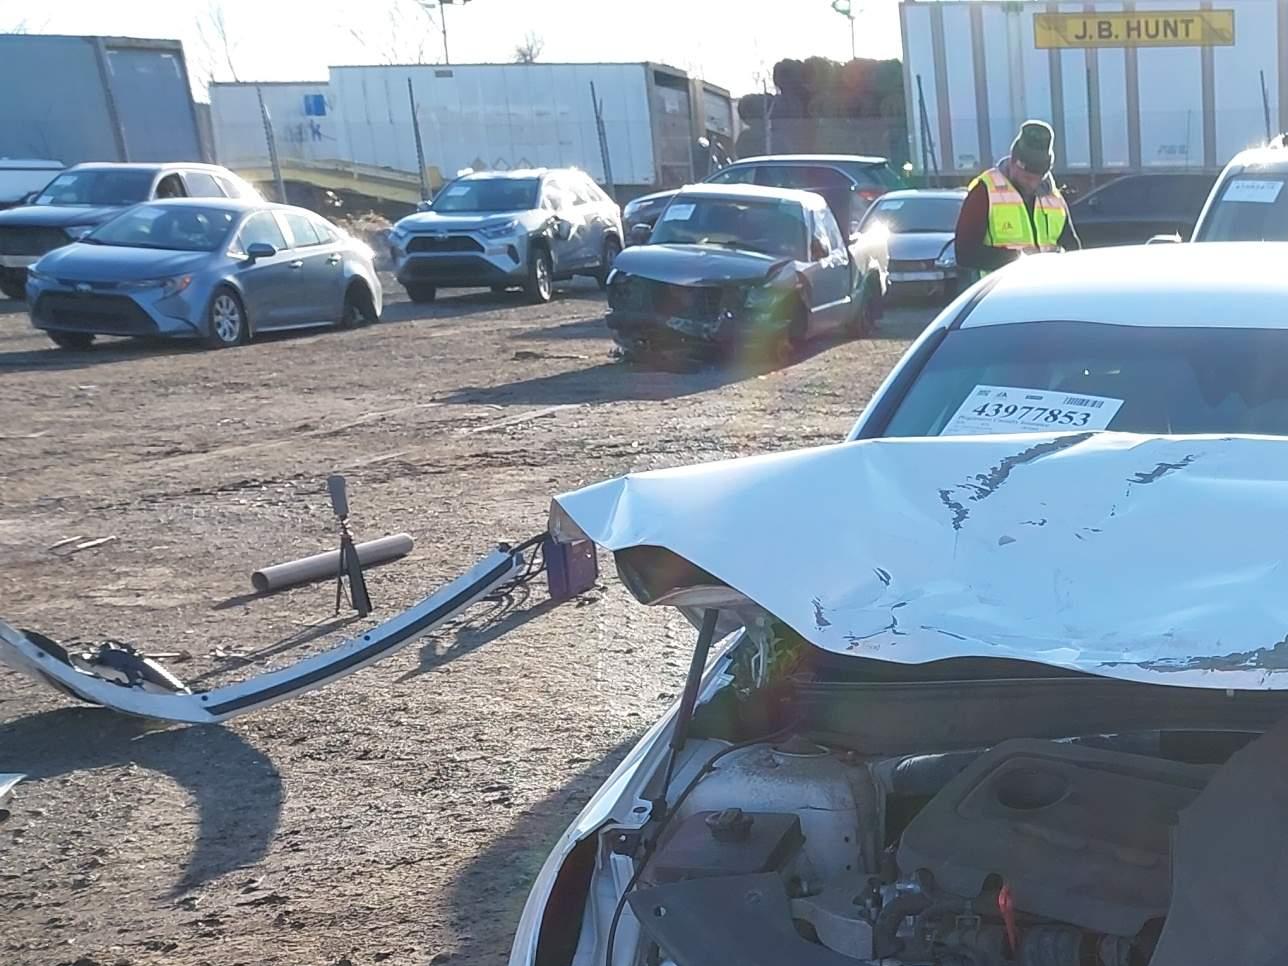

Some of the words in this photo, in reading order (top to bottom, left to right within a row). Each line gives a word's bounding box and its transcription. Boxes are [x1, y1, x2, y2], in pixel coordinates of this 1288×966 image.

[1075, 20, 1119, 39] J.B.
[1126, 18, 1194, 38] HUNT
[973, 402, 1091, 427] 43977853
